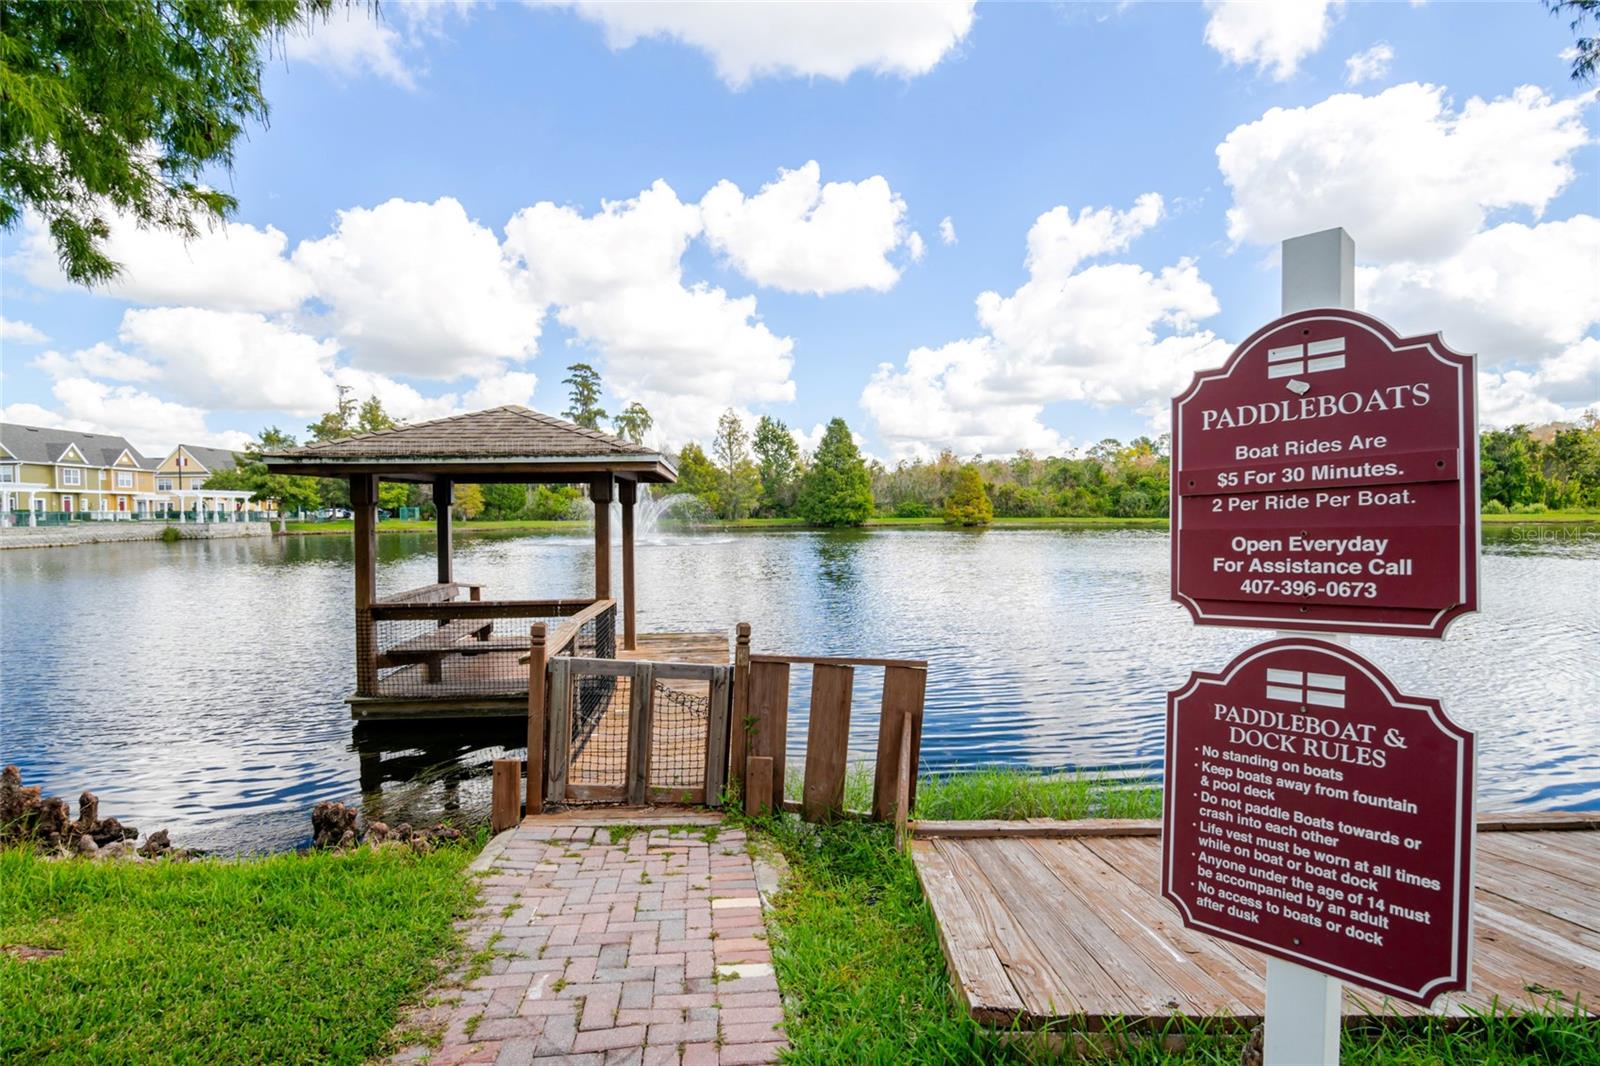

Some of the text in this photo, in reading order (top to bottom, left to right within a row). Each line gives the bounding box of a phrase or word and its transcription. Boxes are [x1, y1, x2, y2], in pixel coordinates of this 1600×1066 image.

[1202, 382, 1430, 431] PADDLEBOATS
[1235, 434, 1387, 460] Boat Rides Are
[1217, 462, 1404, 488] $5 For 30 Minutes.
[1212, 489, 1416, 512] 2 Per Ride Per Boat.
[1231, 536, 1388, 556] Open Everyday
[1213, 558, 1412, 575] For Assistance Call
[1240, 580, 1377, 598] 407-396-0673
[1214, 703, 1408, 749] PADDLEBOAT &
[1202, 745, 1344, 781] No standing on boats
[1229, 727, 1386, 768] DOCK RULES
[1200, 776, 1275, 800] & pool deck
[1201, 761, 1418, 814] Keep boats away from fountain
[1199, 807, 1339, 847] crash into each other
[1201, 791, 1422, 850] Do not paddle Boats towards or
[1198, 837, 1378, 892] while on boat or boat dock
[1200, 821, 1441, 891] Life vest must be worn at all times
[1197, 865, 1389, 929] be accompanied by an adult
[1198, 852, 1431, 925] Anyone under the age of 14 must
[1196, 896, 1260, 923] after dusk
[1198, 881, 1383, 946] No access to boats or dock
